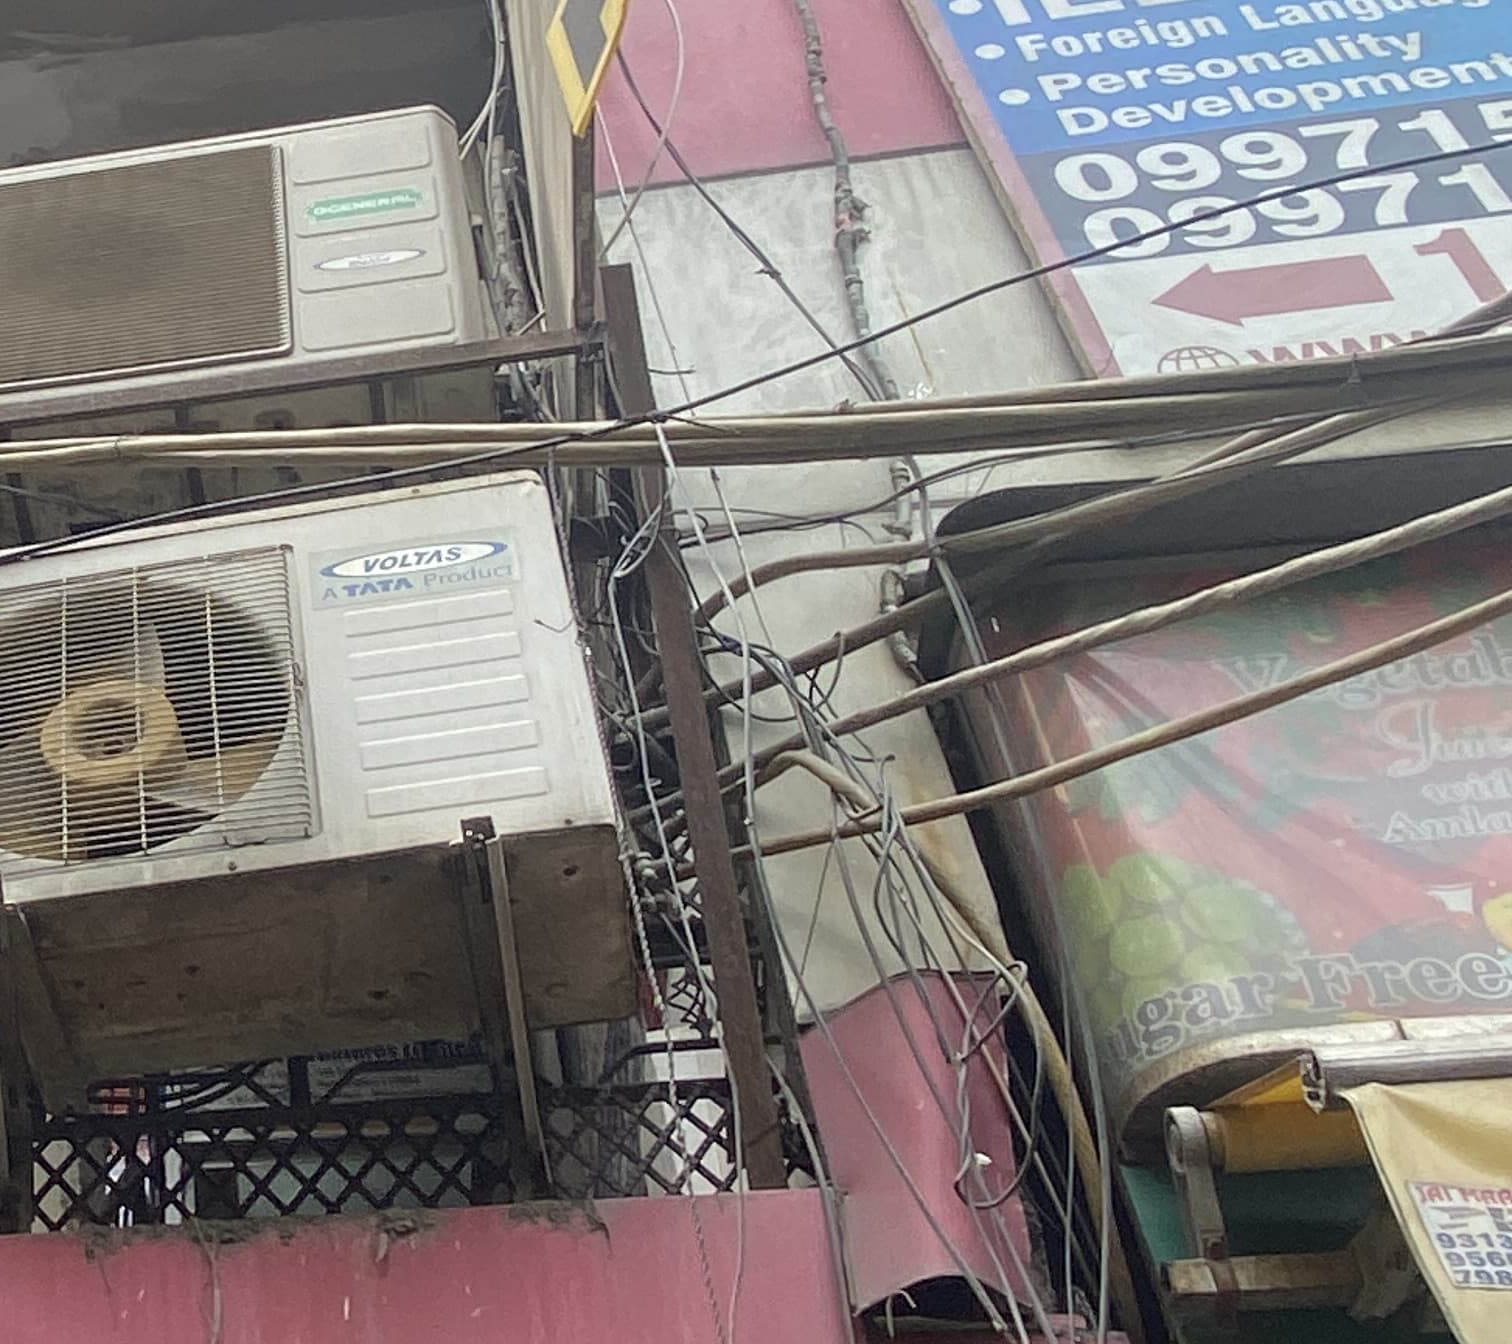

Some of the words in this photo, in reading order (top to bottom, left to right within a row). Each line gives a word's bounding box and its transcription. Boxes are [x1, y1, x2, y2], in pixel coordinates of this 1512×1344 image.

[1015, 10, 1229, 63] Foreign
[1036, 29, 1423, 104] Personality
[1055, 51, 1512, 137] Development
[321, 587, 338, 602] A
[343, 576, 414, 598] TATA
[422, 563, 515, 588] Product
[363, 546, 463, 574] VOLTAS
[1291, 950, 1512, 1011] Free
